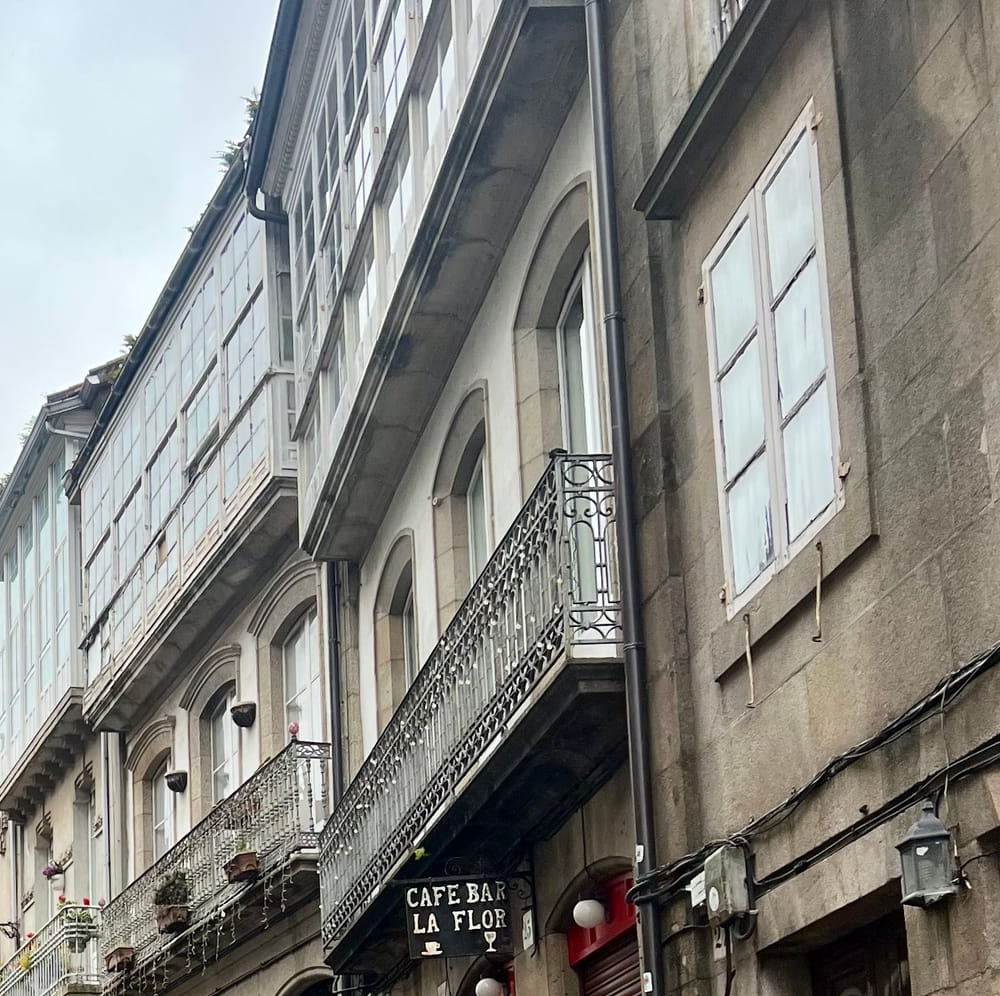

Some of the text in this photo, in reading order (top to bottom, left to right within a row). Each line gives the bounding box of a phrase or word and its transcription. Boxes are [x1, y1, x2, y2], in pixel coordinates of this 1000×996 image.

[406, 881, 506, 908] CAFE BAR
[413, 908, 507, 934] LA FLOR
